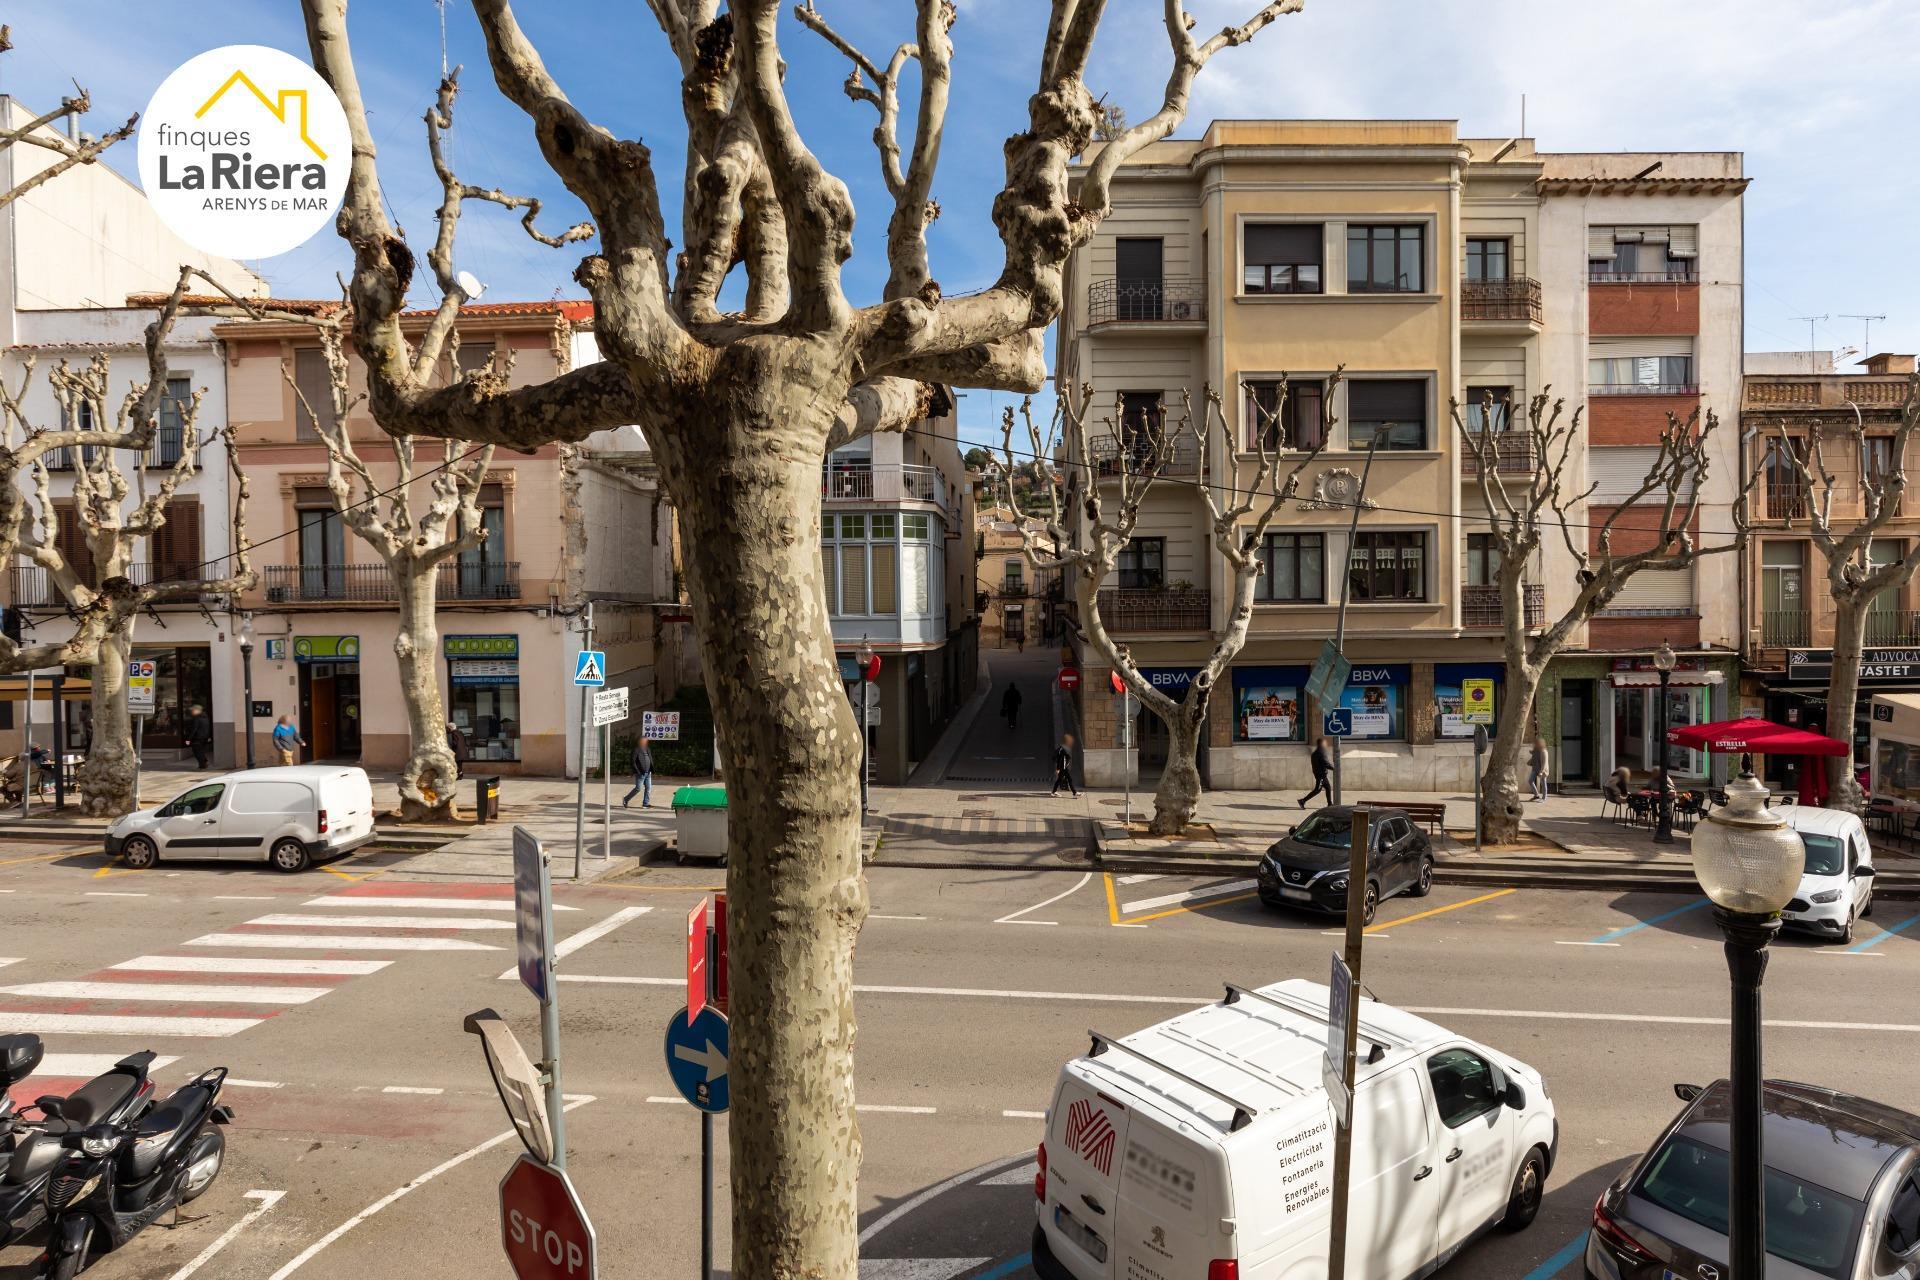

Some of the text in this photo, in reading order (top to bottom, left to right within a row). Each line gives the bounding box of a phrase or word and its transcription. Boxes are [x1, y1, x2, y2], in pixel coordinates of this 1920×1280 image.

[1872, 651, 1920, 662] ADVOCA
[1152, 671, 1191, 685] BBVA
[1352, 669, 1391, 681] BBVA
[1276, 1120, 1327, 1151] Climatització
[1279, 1142, 1323, 1168] Electricitat
[1282, 1160, 1324, 1186] Fontaneria
[1284, 1180, 1319, 1203] Energies
[1286, 1186, 1330, 1215] Renovables
[509, 1208, 583, 1274] STOP
